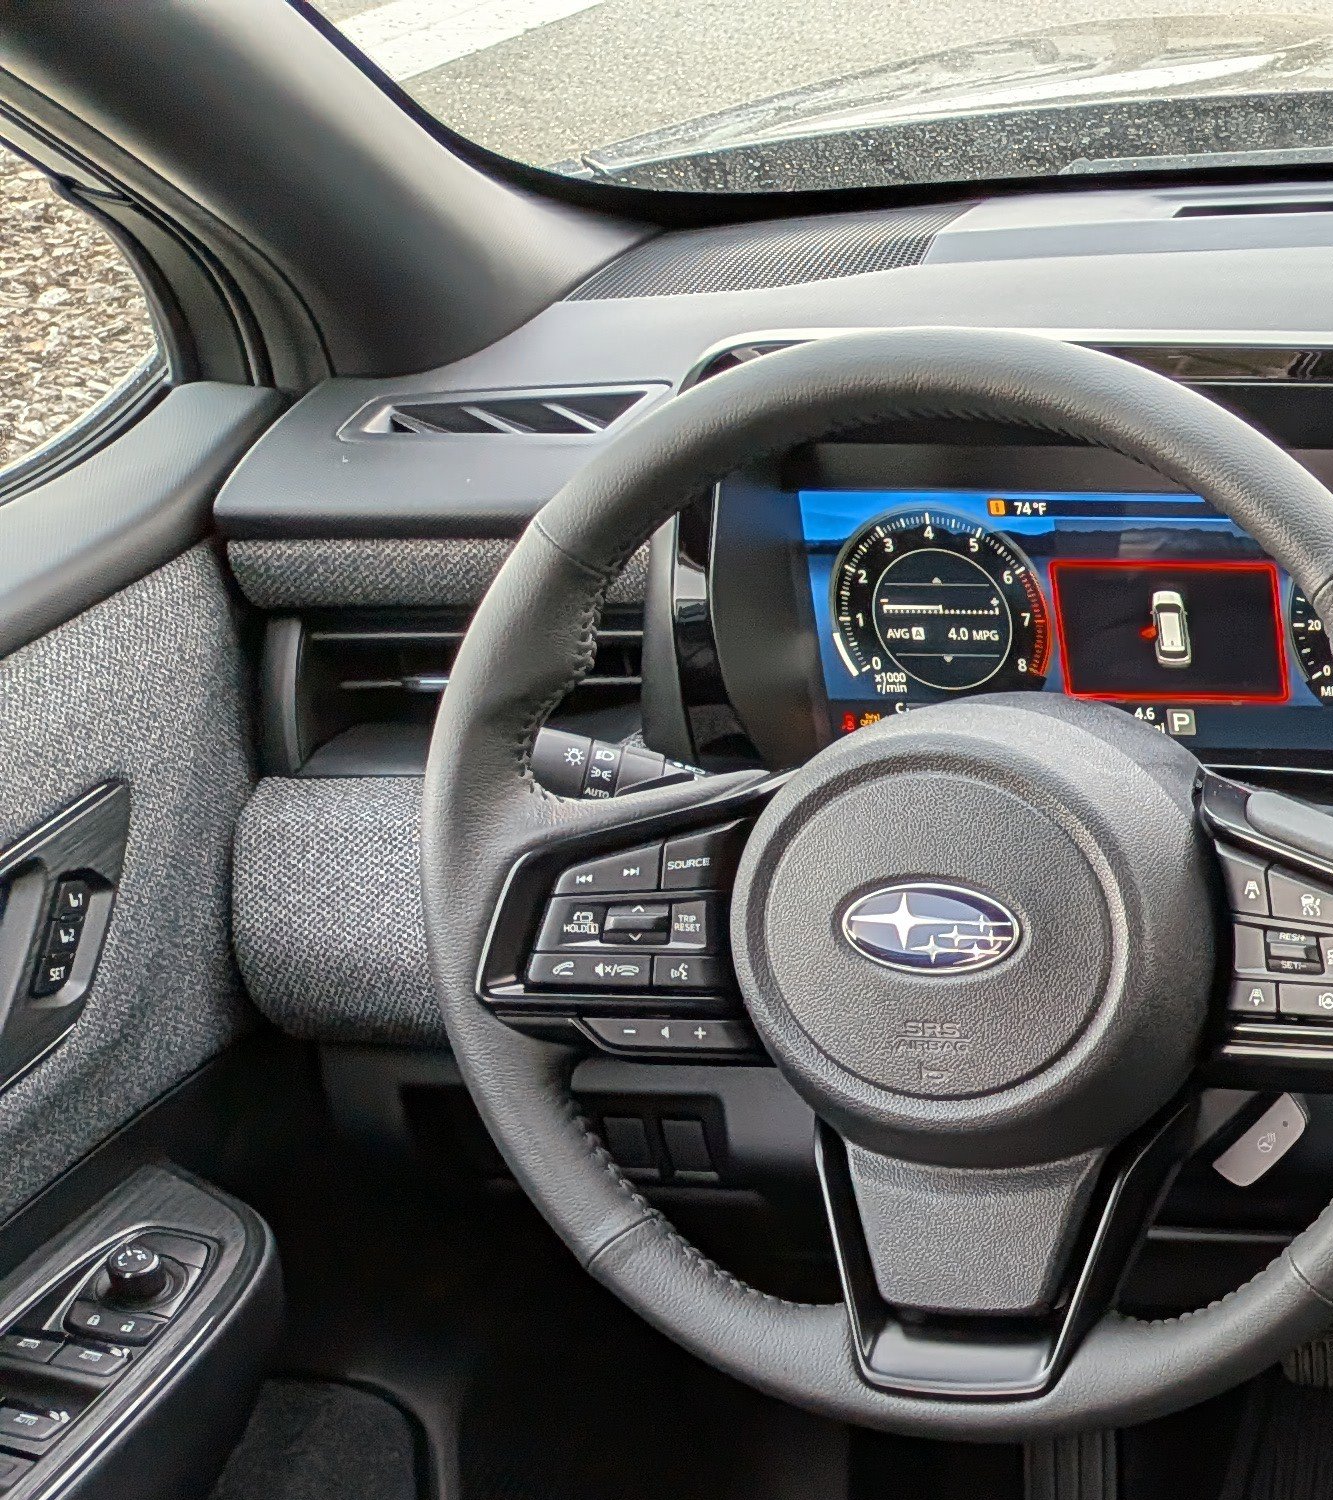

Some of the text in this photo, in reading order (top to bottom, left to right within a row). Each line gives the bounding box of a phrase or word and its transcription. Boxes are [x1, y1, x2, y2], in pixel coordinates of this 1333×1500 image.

[1013, 502, 1047, 516] 74°F
[923, 526, 934, 540] 4
[883, 538, 894, 552] 3
[969, 538, 979, 552] 5
[857, 570, 868, 584] 2
[1003, 571, 1013, 585] 6
[856, 613, 864, 627] 1
[1020, 613, 1031, 627] 7
[1307, 620, 1322, 631] 20
[886, 628, 910, 640] AVG
[948, 627, 999, 641] 4.0 MPG
[872, 656, 882, 670] 0
[1017, 658, 1028, 672] 8
[874, 672, 907, 683] x1000
[1322, 666, 1331, 677] 0
[876, 682, 908, 695] r/min
[1134, 707, 1156, 720] 4.6
[1172, 713, 1190, 732] P
[584, 787, 610, 799] AUTO
[667, 857, 711, 871] SOURCE
[678, 914, 697, 923] TRIP
[674, 923, 701, 933] RESET
[49, 966, 66, 982] SET
[904, 1020, 960, 1038] SRS
